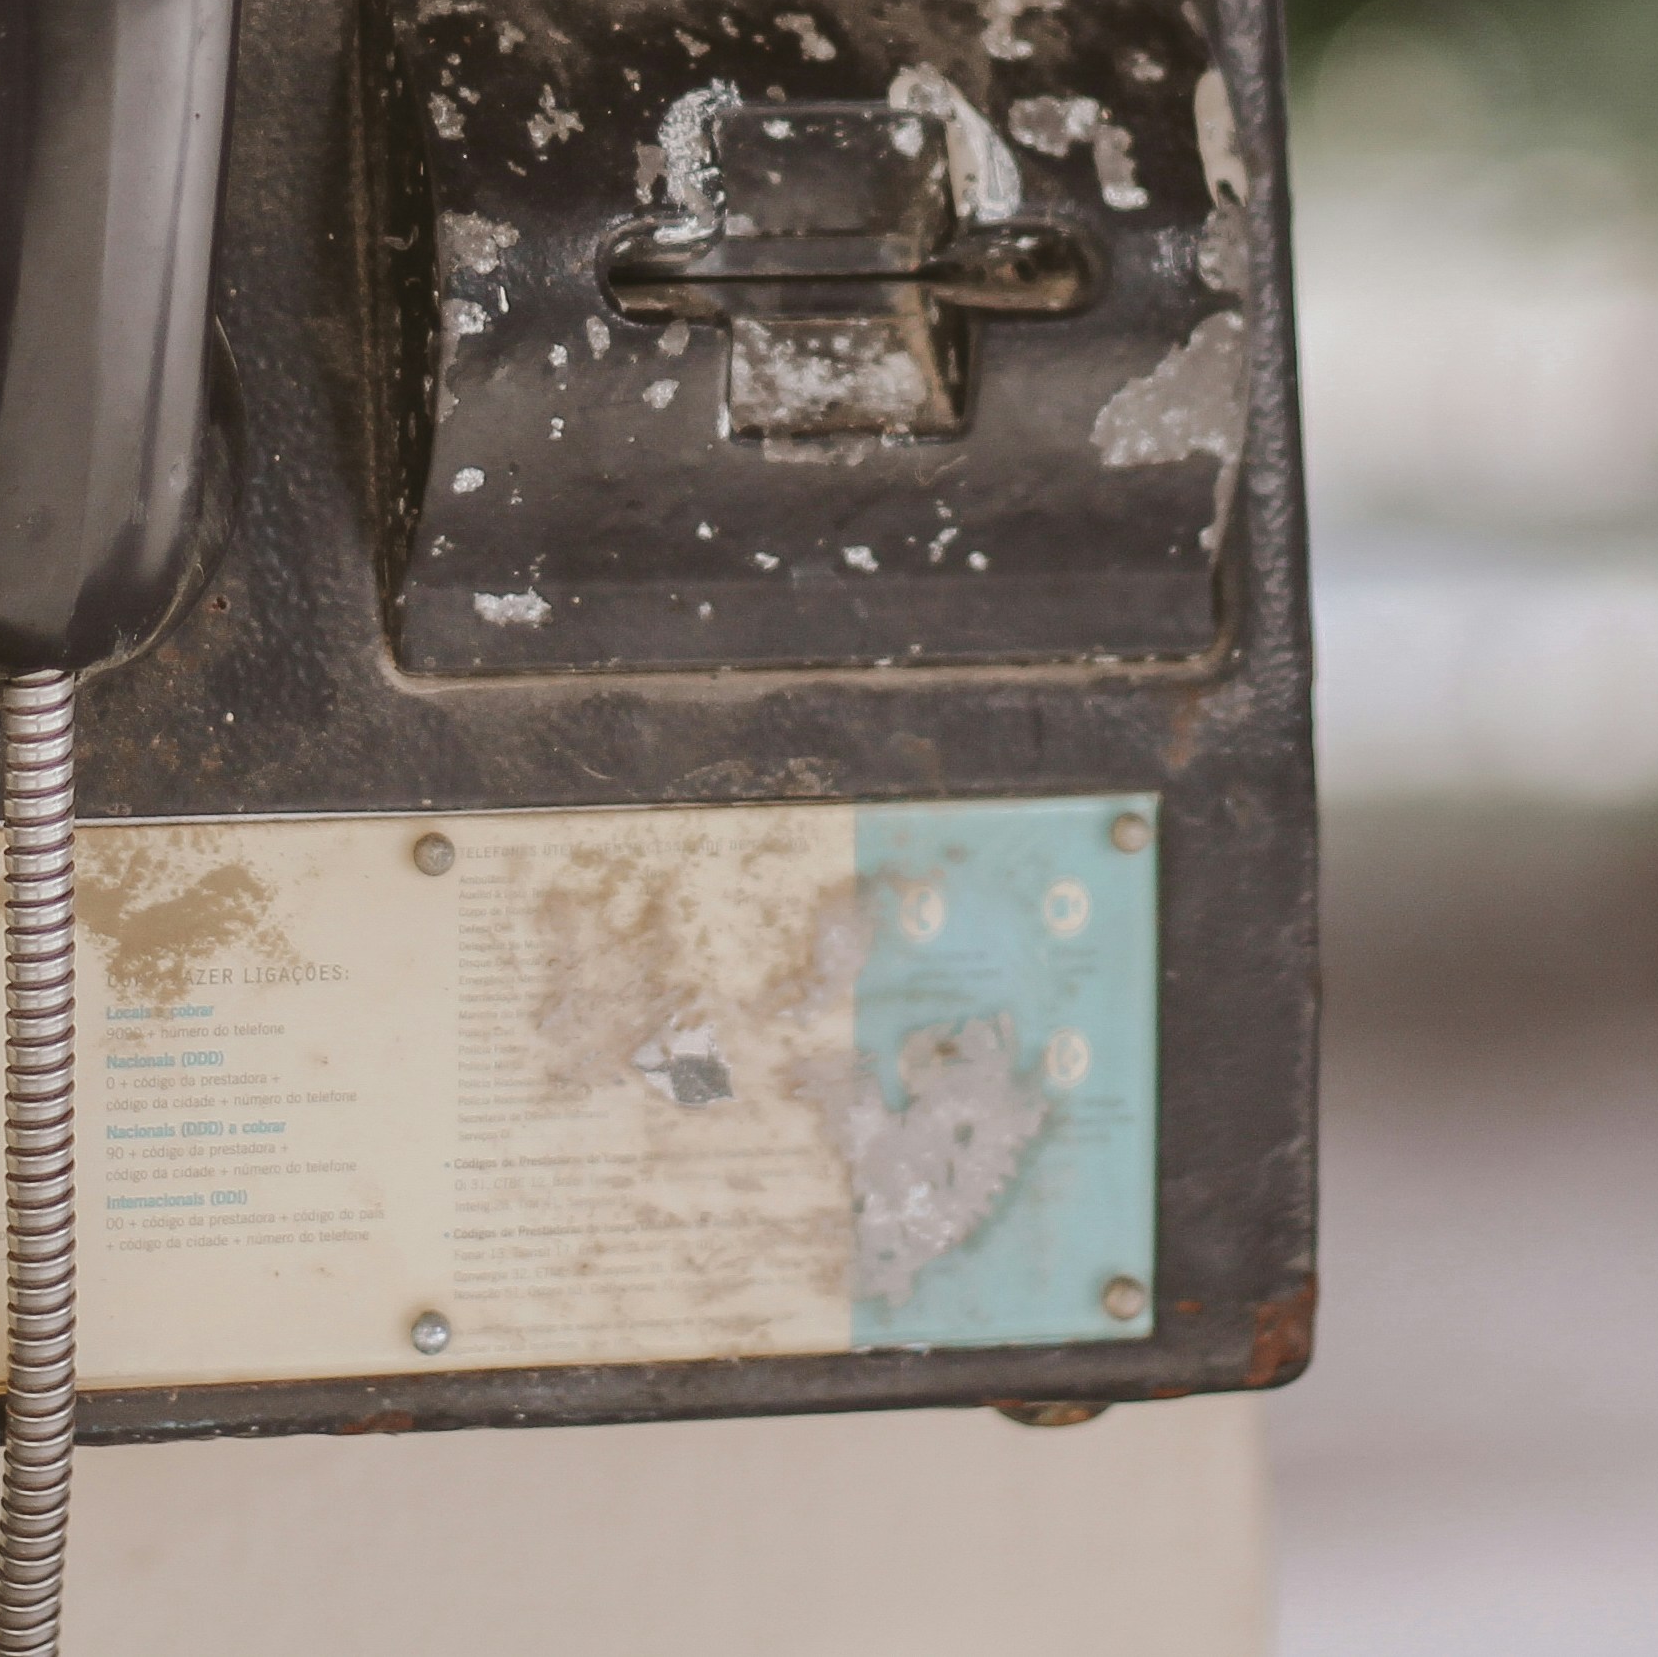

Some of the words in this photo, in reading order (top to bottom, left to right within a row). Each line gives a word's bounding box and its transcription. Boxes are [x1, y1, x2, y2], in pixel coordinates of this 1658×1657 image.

[243, 962, 351, 987] LIGAÇÕES:
[106, 1006, 151, 1021] Locais
[172, 1003, 215, 1018] cobrar
[160, 1025, 209, 1040] número
[214, 1024, 230, 1037] do
[234, 1022, 285, 1037] telefone
[106, 1053, 176, 1069] Nacionais
[181, 1050, 225, 1068] (DDD)
[134, 1075, 176, 1091] código
[180, 1075, 196, 1088] da
[200, 1072, 268, 1088] prestadora
[106, 1097, 148, 1113] código
[152, 1097, 168, 1110] da
[173, 1094, 216, 1109] cidade
[234, 1092, 282, 1107] número
[286, 1091, 302, 1104] do
[306, 1089, 358, 1104] telefone
[106, 1123, 176, 1140] Nacionais
[181, 1121, 225, 1139] (DDD)
[242, 1119, 287, 1135] cobrar
[106, 1146, 124, 1160] 90
[142, 1144, 184, 1160] código
[189, 1144, 205, 1157] da
[209, 1142, 276, 1158] prestadora
[106, 1167, 148, 1183] código
[152, 1167, 168, 1180] da
[172, 1165, 216, 1179] cidade
[233, 1162, 282, 1177] número
[286, 1161, 302, 1174] do
[306, 1159, 358, 1174] telefone
[106, 1192, 205, 1210] Internacionais
[210, 1189, 248, 1206] (DDI)
[106, 1216, 124, 1230] 00
[142, 1214, 184, 1231] código
[189, 1214, 205, 1227] da
[209, 1212, 276, 1229] prestadora
[293, 1209, 335, 1225] código
[119, 1237, 162, 1253] código
[166, 1236, 181, 1249] da
[186, 1234, 229, 1248] cidade
[246, 1232, 294, 1247] número
[299, 1230, 315, 1243] do
[319, 1228, 369, 1243] telefone
